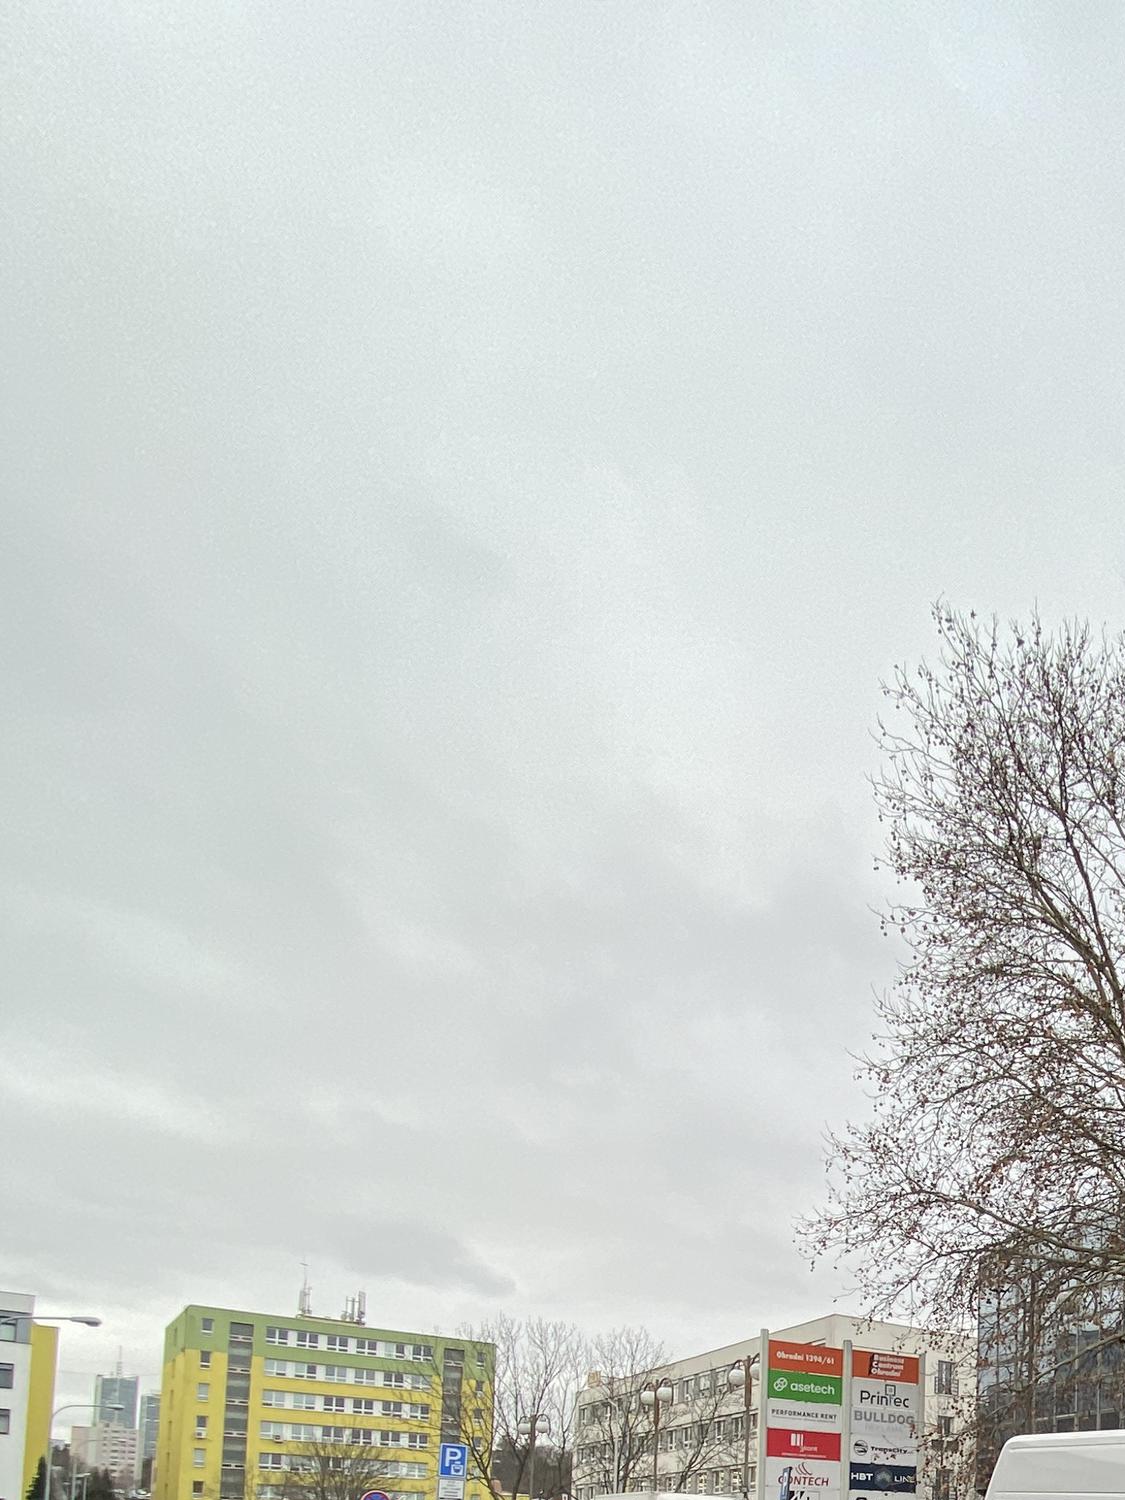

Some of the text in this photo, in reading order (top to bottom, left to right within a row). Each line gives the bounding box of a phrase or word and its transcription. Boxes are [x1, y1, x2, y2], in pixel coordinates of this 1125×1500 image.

[790, 1382, 835, 1395] asetech
[771, 1408, 838, 1420] PERFORMANCE RENT
[854, 1410, 915, 1424] BULLDOG
[445, 1447, 462, 1467] P
[850, 1472, 873, 1481] HBT
